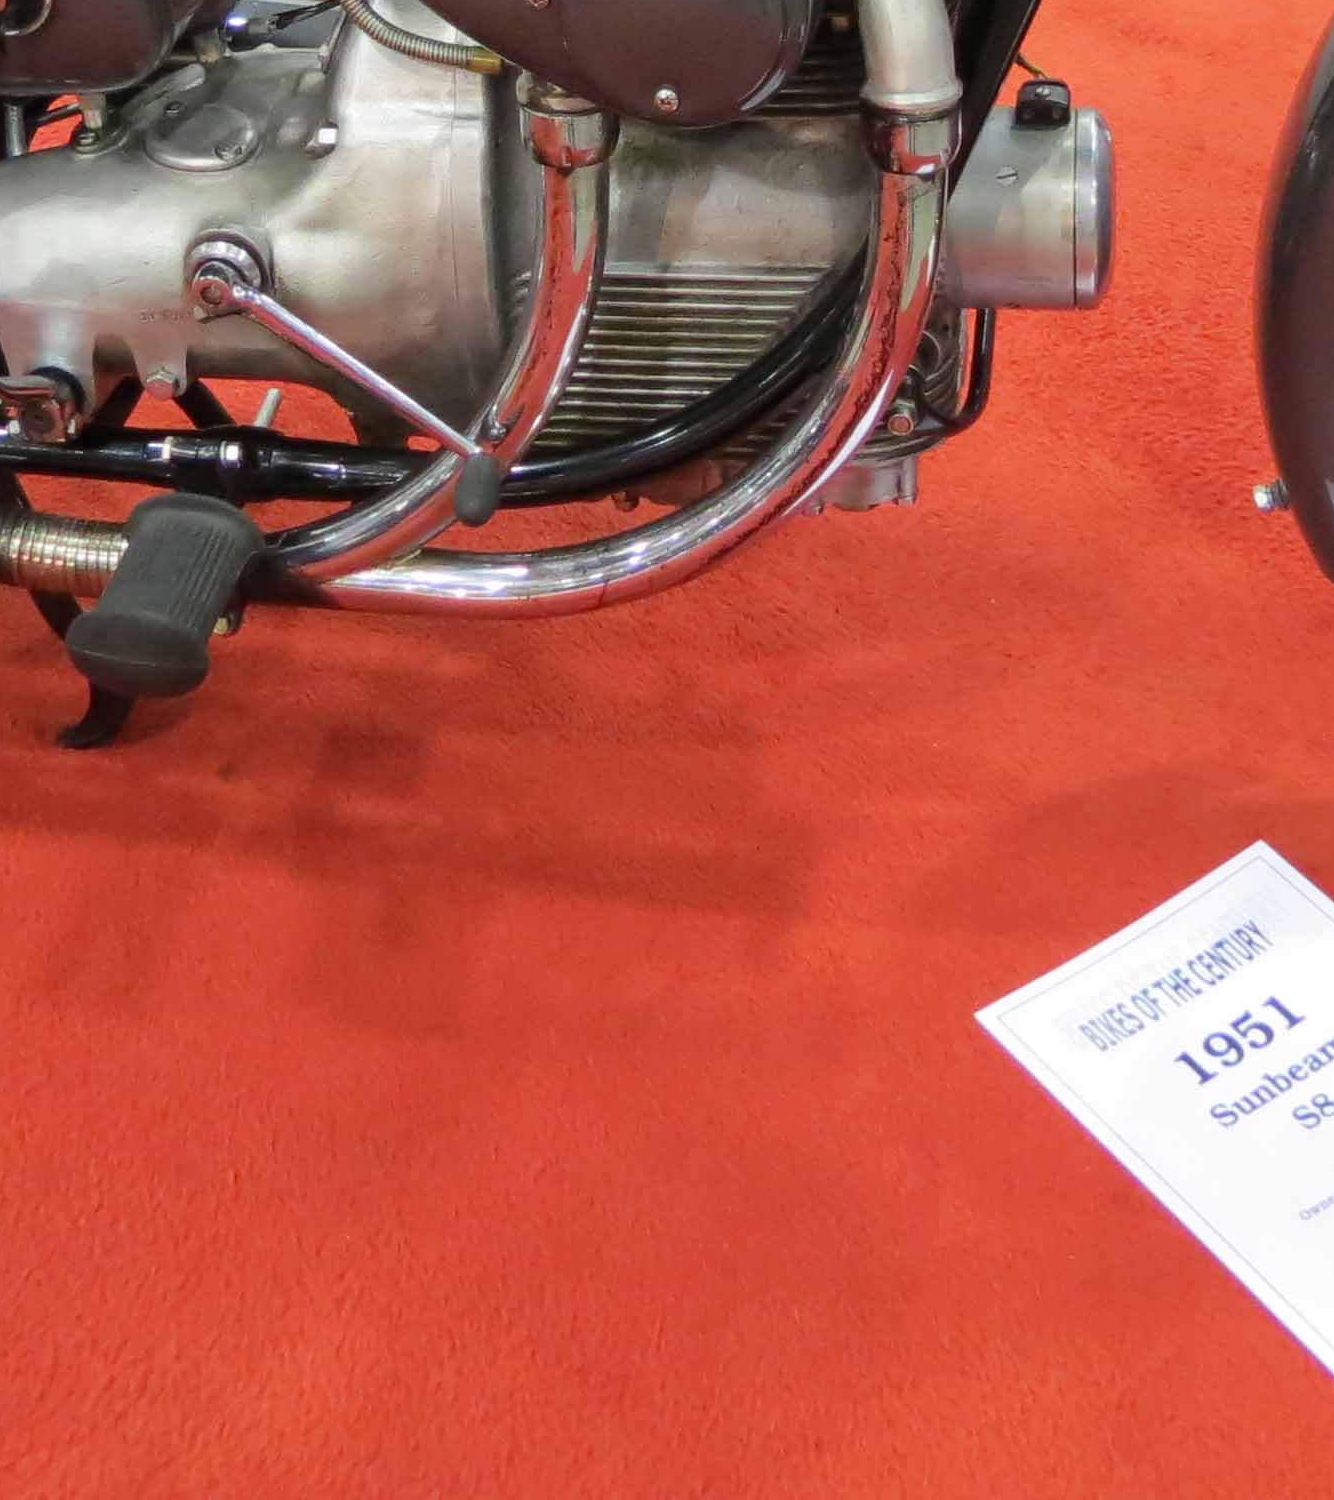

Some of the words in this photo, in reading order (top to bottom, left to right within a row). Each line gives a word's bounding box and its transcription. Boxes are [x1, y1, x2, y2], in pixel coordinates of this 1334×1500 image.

[1079, 1002, 1145, 1051] BIKES
[1130, 987, 1168, 1022] OF
[1152, 967, 1204, 1007] THE
[1187, 919, 1274, 986] CENTURY
[1173, 996, 1306, 1086] 1951
